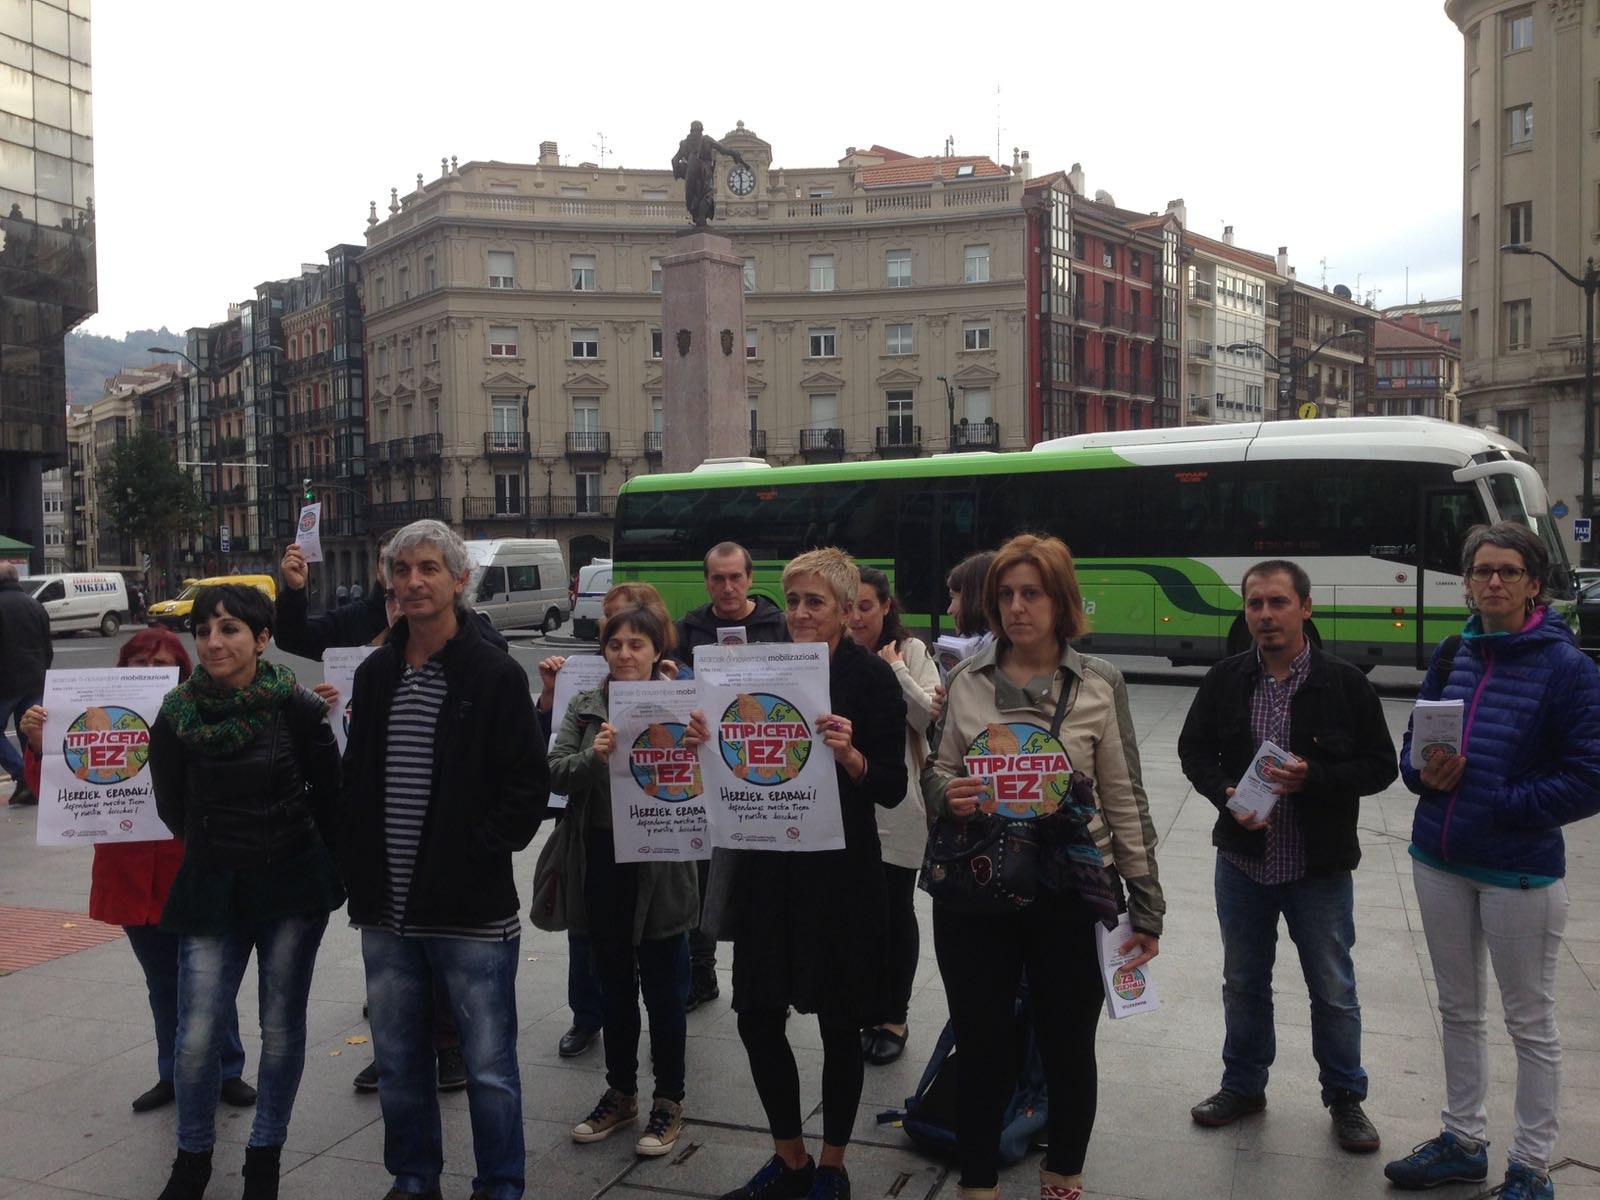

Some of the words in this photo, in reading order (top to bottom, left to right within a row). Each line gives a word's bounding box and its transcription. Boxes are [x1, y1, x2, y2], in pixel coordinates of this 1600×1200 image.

[75, 582, 117, 593] MIKELDI
[1081, 597, 1096, 615] ia
[767, 652, 820, 662] mobilizazioak
[67, 730, 150, 747] TTIP/CETA
[722, 723, 810, 739] TTIP/CETA
[90, 745, 125, 767] EZ
[748, 740, 784, 764] EZ
[657, 763, 692, 783] EZ
[965, 754, 1070, 775] TTIP/CETA
[996, 774, 1041, 800] EZ
[675, 806, 707, 818] ERABA
[767, 802, 790, 811] nuestra
